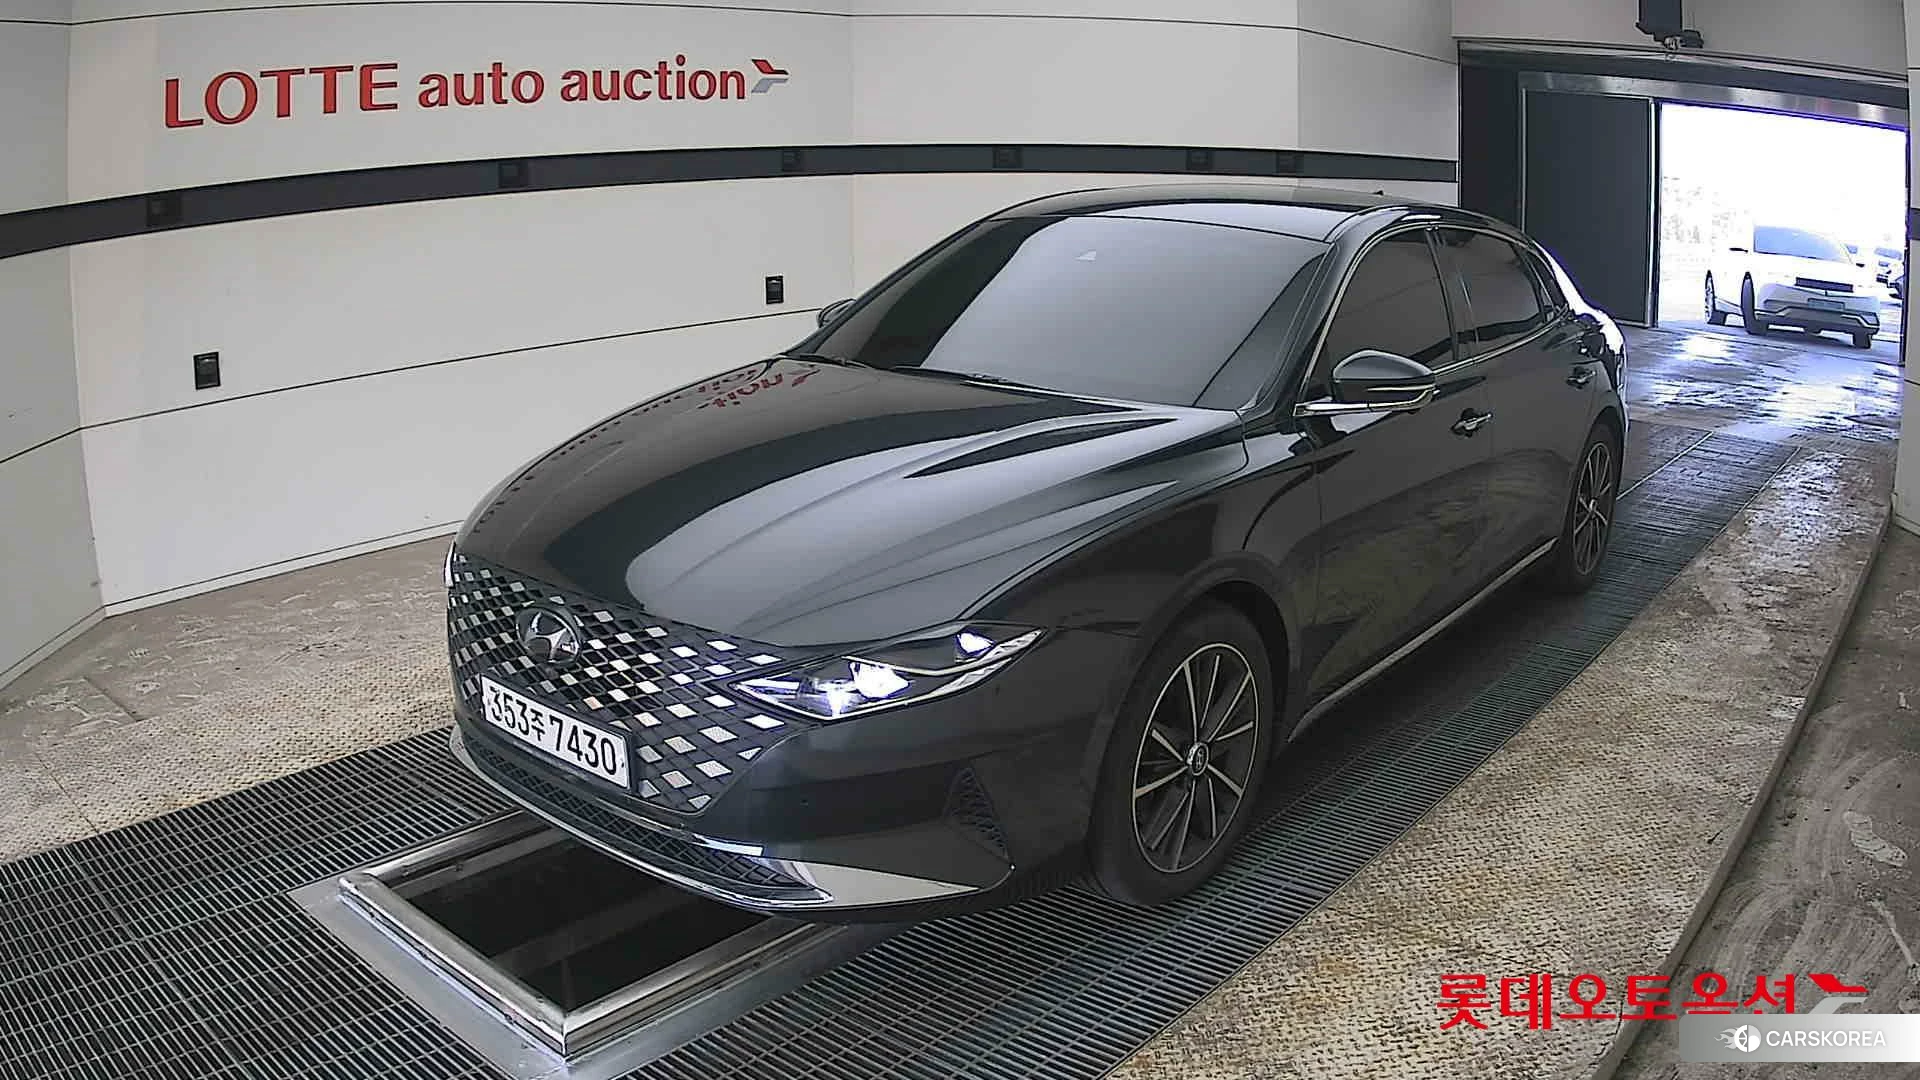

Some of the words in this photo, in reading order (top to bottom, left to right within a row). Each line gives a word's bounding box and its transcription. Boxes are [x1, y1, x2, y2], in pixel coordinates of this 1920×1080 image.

[164, 63, 399, 128] LOTTE
[418, 62, 545, 108] auto
[560, 54, 746, 101] auction
[549, 714, 617, 776] 7430
